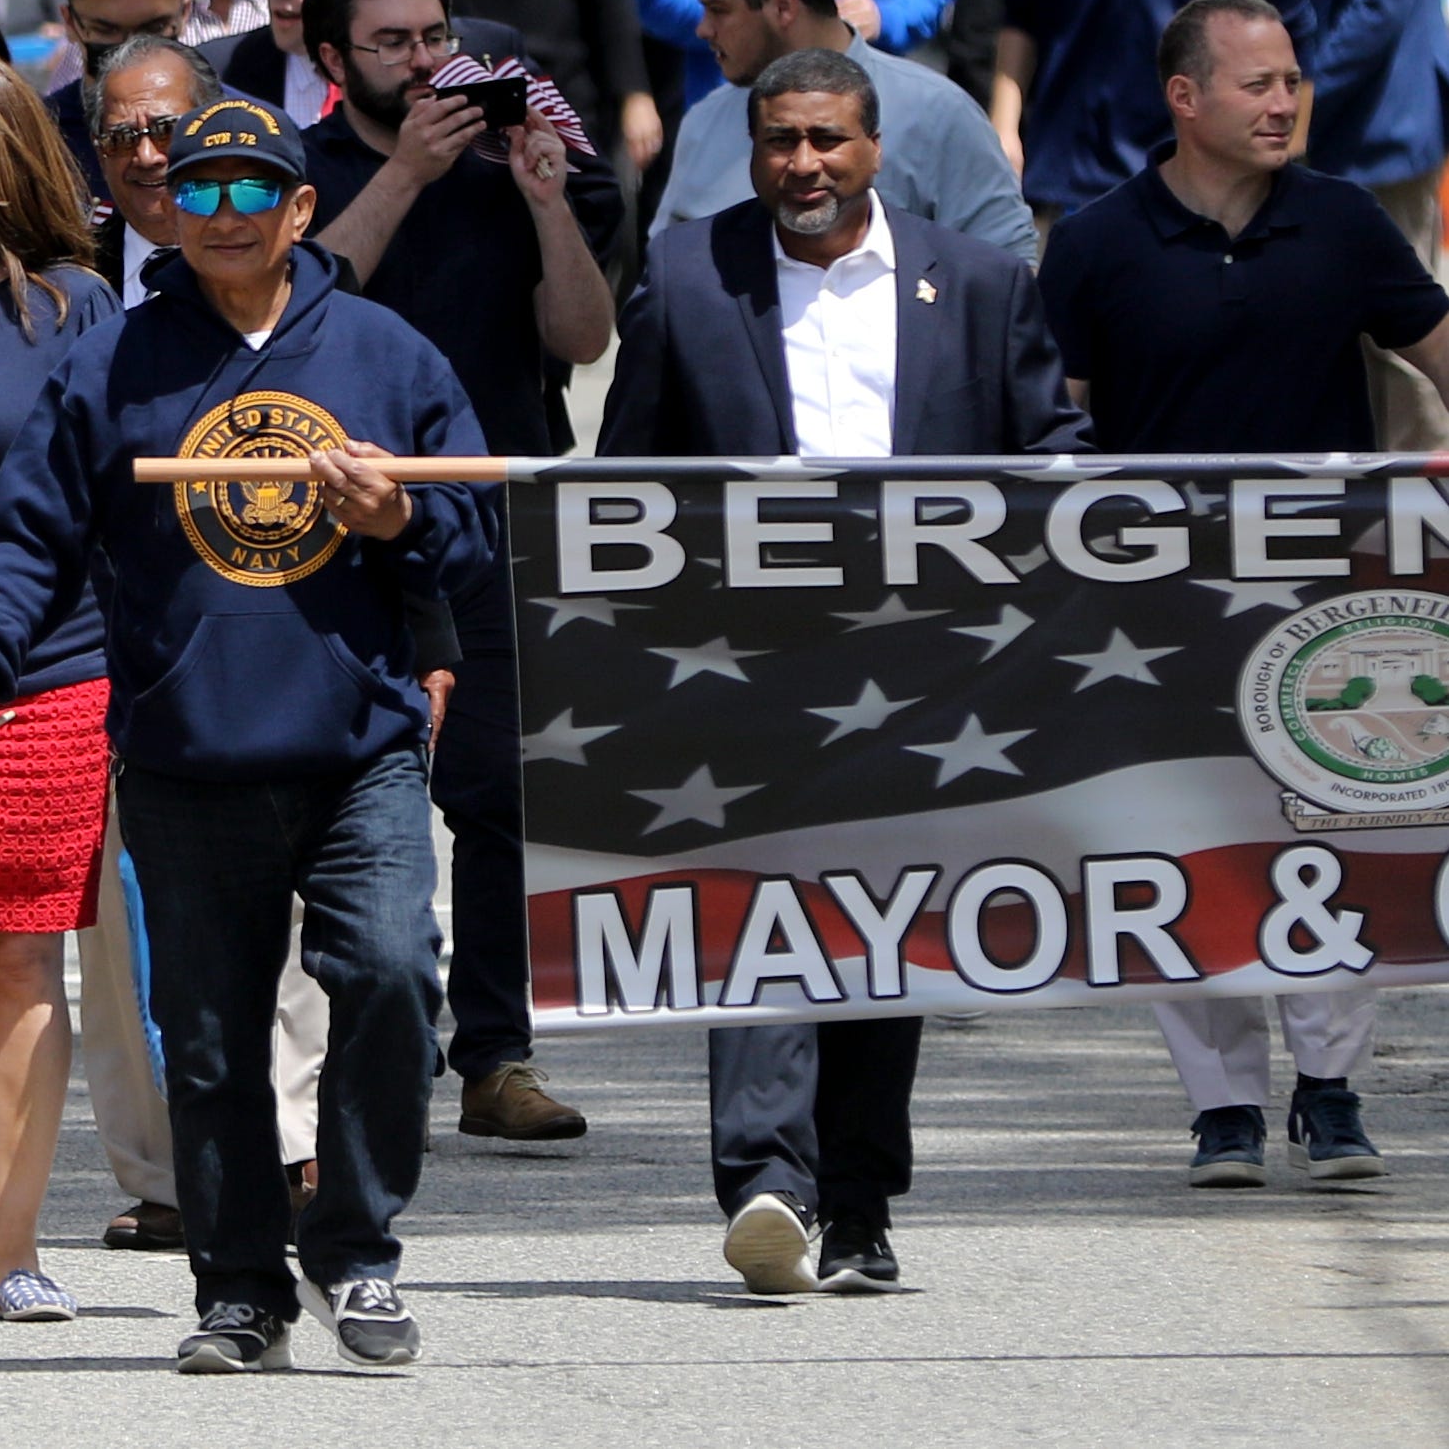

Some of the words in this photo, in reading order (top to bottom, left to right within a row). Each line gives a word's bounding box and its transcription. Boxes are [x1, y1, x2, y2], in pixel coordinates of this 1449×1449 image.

[204, 132, 232, 147] CVN
[238, 132, 257, 146] 72
[268, 408, 336, 453] STATE
[231, 545, 301, 570] NAVY
[1343, 617, 1436, 634] RELIGION
[1253, 661, 1276, 733] BOROUGH
[1269, 642, 1288, 659] OF
[1280, 658, 1307, 741] COMMERCE
[1362, 769, 1429, 782] HOMES
[1330, 782, 1428, 803] INCORPORATED
[1346, 812, 1427, 827] FRIENDLY
[572, 855, 1204, 1017] MAYOR
[1260, 843, 1376, 978] &
